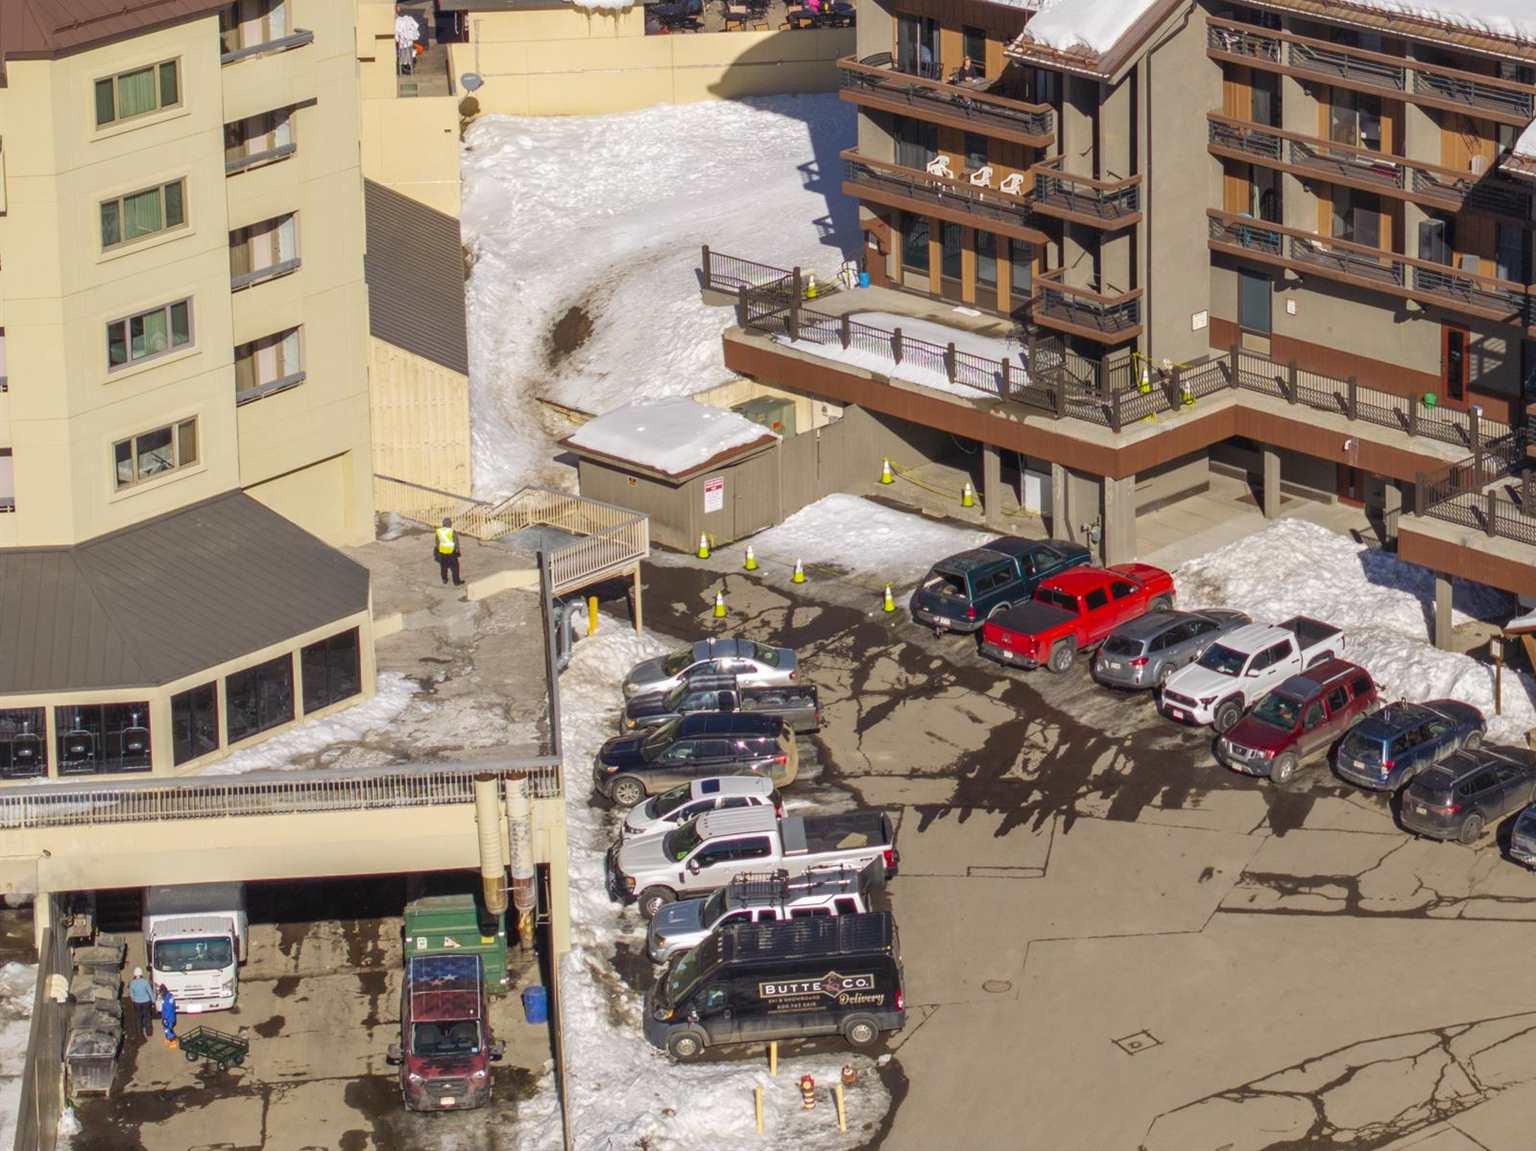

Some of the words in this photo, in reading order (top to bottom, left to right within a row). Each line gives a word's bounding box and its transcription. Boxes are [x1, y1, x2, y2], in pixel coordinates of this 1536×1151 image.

[765, 982, 822, 994] BUTTE
[842, 978, 869, 988] CO.
[839, 992, 885, 1006] Delivery
